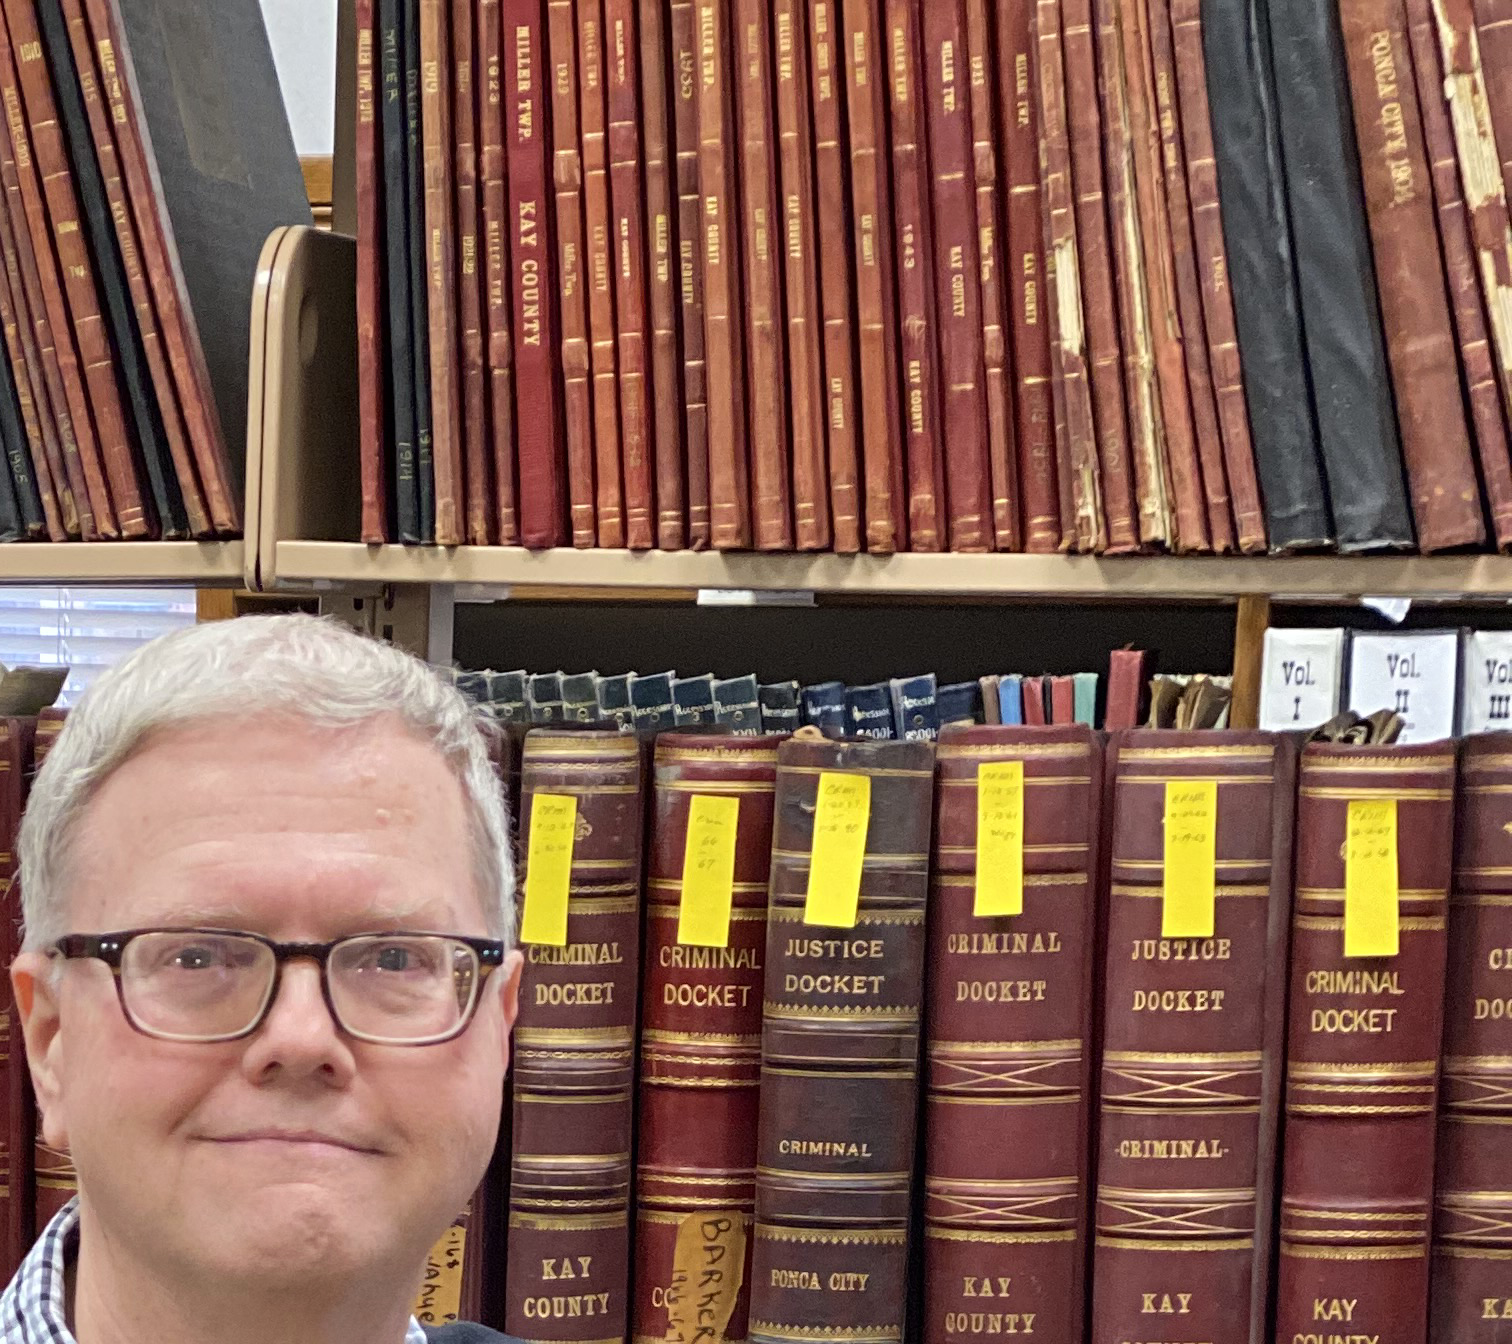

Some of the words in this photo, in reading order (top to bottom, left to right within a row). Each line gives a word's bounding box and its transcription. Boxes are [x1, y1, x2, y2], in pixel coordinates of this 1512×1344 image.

[516, 25, 532, 93] MILLER
[519, 200, 538, 247] KAY
[521, 258, 541, 347] COUNTY
[951, 273, 965, 317] COUNTY
[1282, 660, 1315, 686] Vol.
[1387, 653, 1421, 679] Vol.
[1395, 690, 1410, 714] II
[528, 943, 623, 965] CRIMINAL
[784, 939, 885, 959] JUSTICE
[947, 932, 1062, 955] CRIMINAL
[1131, 938, 1232, 962] JUSTICE
[659, 945, 762, 970] CRIMINAL
[535, 982, 615, 1005] DOCKET
[663, 984, 752, 1008] DOCKET
[784, 975, 886, 995] DOCKET
[956, 980, 1047, 1003] DOCKET
[1305, 971, 1405, 997] CRIMINAL
[1133, 990, 1225, 1012] DOCKET
[1311, 1009, 1398, 1033] DOCKET
[778, 1140, 873, 1158] CRIMINAL
[542, 1256, 592, 1280] KAY
[770, 1270, 822, 1291] PONCA
[829, 1272, 870, 1292] CITY
[963, 1277, 1011, 1297] KAY
[523, 1293, 610, 1318] COUNTY
[1142, 1293, 1193, 1314] KAY
[1313, 1299, 1358, 1321] KAY
[945, 1313, 1037, 1334] COUNTY
